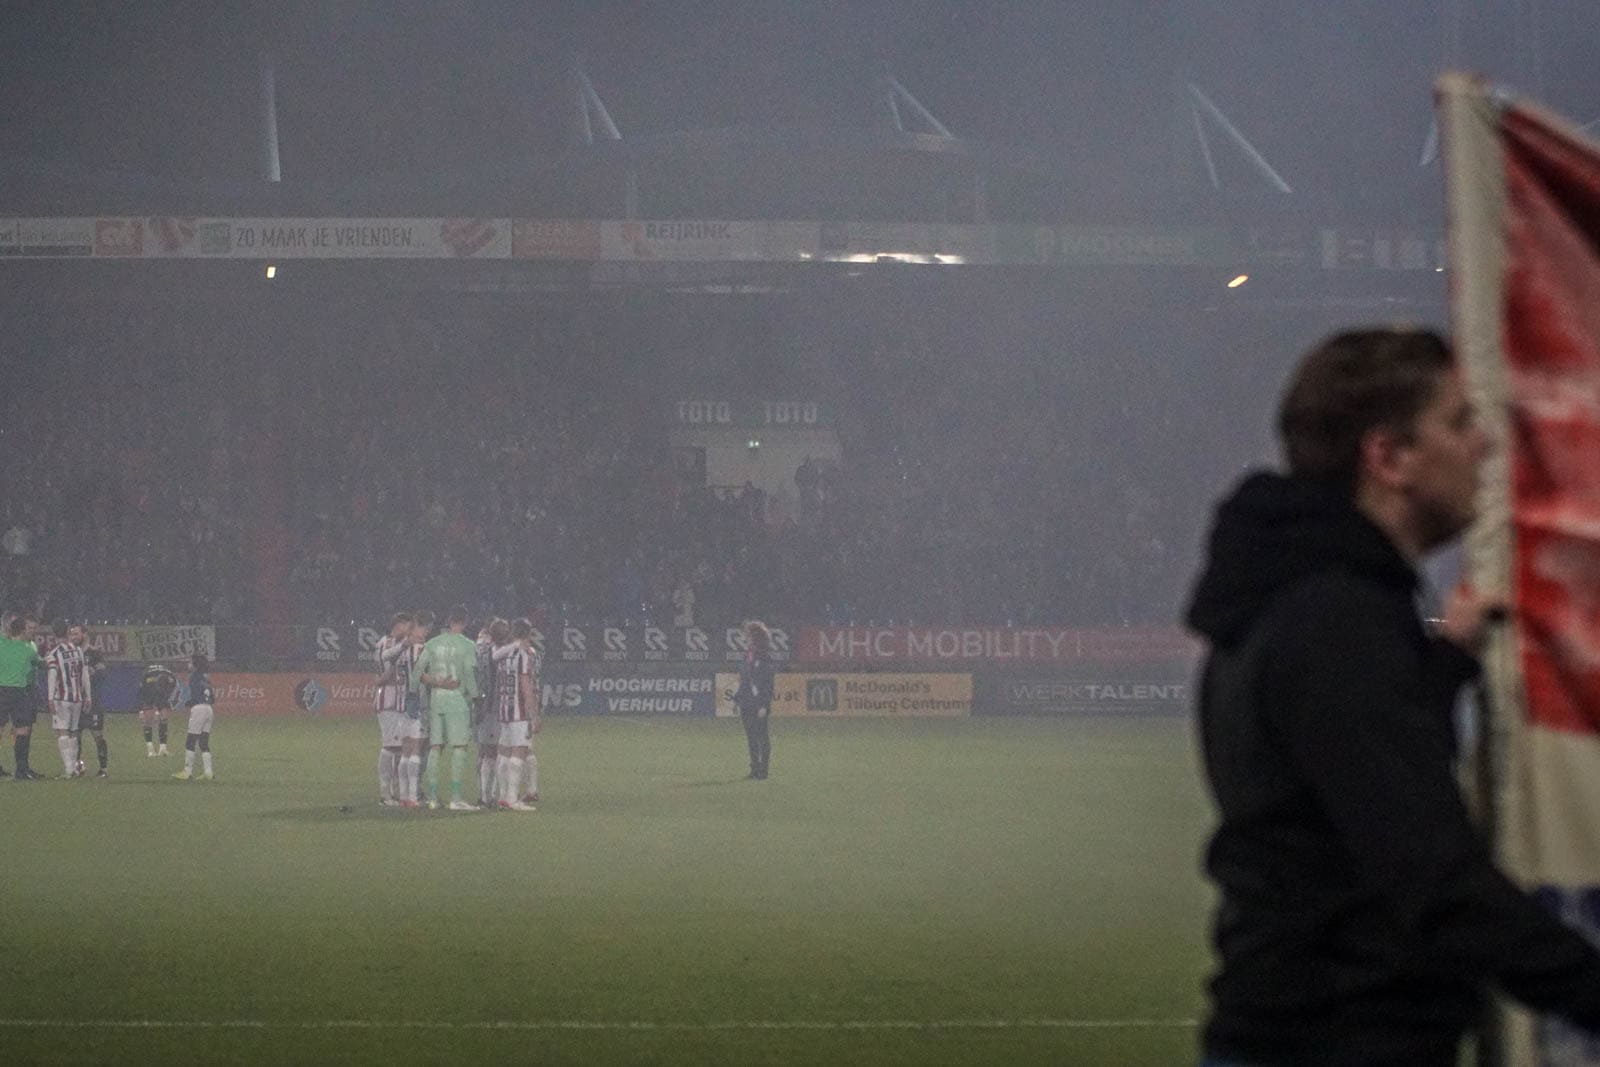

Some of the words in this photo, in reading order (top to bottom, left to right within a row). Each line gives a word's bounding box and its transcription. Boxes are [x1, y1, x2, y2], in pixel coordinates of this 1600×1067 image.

[236, 227, 255, 248] ZO
[261, 227, 307, 248] MAAK
[312, 227, 330, 248] JE
[819, 630, 895, 657] MHC
[907, 630, 1067, 658] MOBILITY
[227, 685, 265, 699] Hees
[331, 685, 360, 699] Van
[588, 678, 713, 693] HOOGWERKER
[845, 681, 931, 694] McDonald's
[784, 690, 800, 702] at
[608, 697, 694, 712] VERHUUR
[845, 698, 897, 713] Tilburg
[900, 698, 965, 710] Centrum
